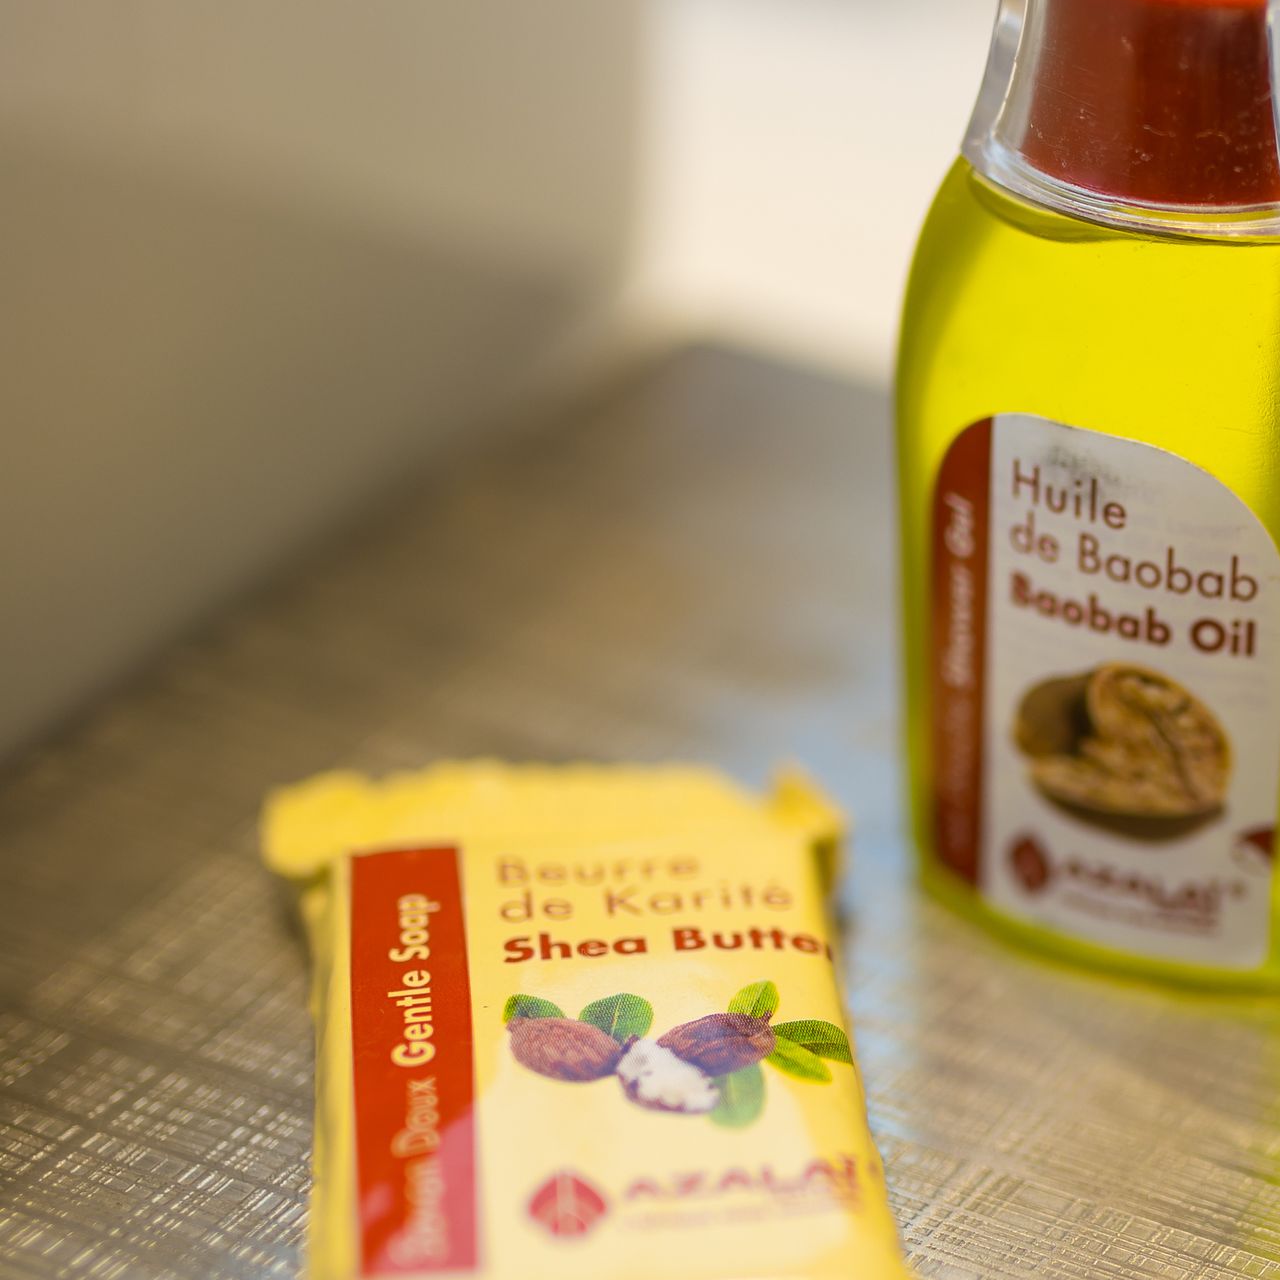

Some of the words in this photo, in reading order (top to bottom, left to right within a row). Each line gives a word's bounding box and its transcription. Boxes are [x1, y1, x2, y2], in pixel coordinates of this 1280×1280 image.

[1012, 458, 1127, 530] Huile
[1009, 510, 1060, 564] de
[1078, 532, 1258, 602] Baobab
[1010, 571, 1172, 647] Baobab
[1189, 617, 1256, 658] Oil
[388, 892, 441, 962] Soap
[499, 887, 574, 923] de
[503, 932, 649, 964] Shea
[387, 968, 437, 1067] Gentle
